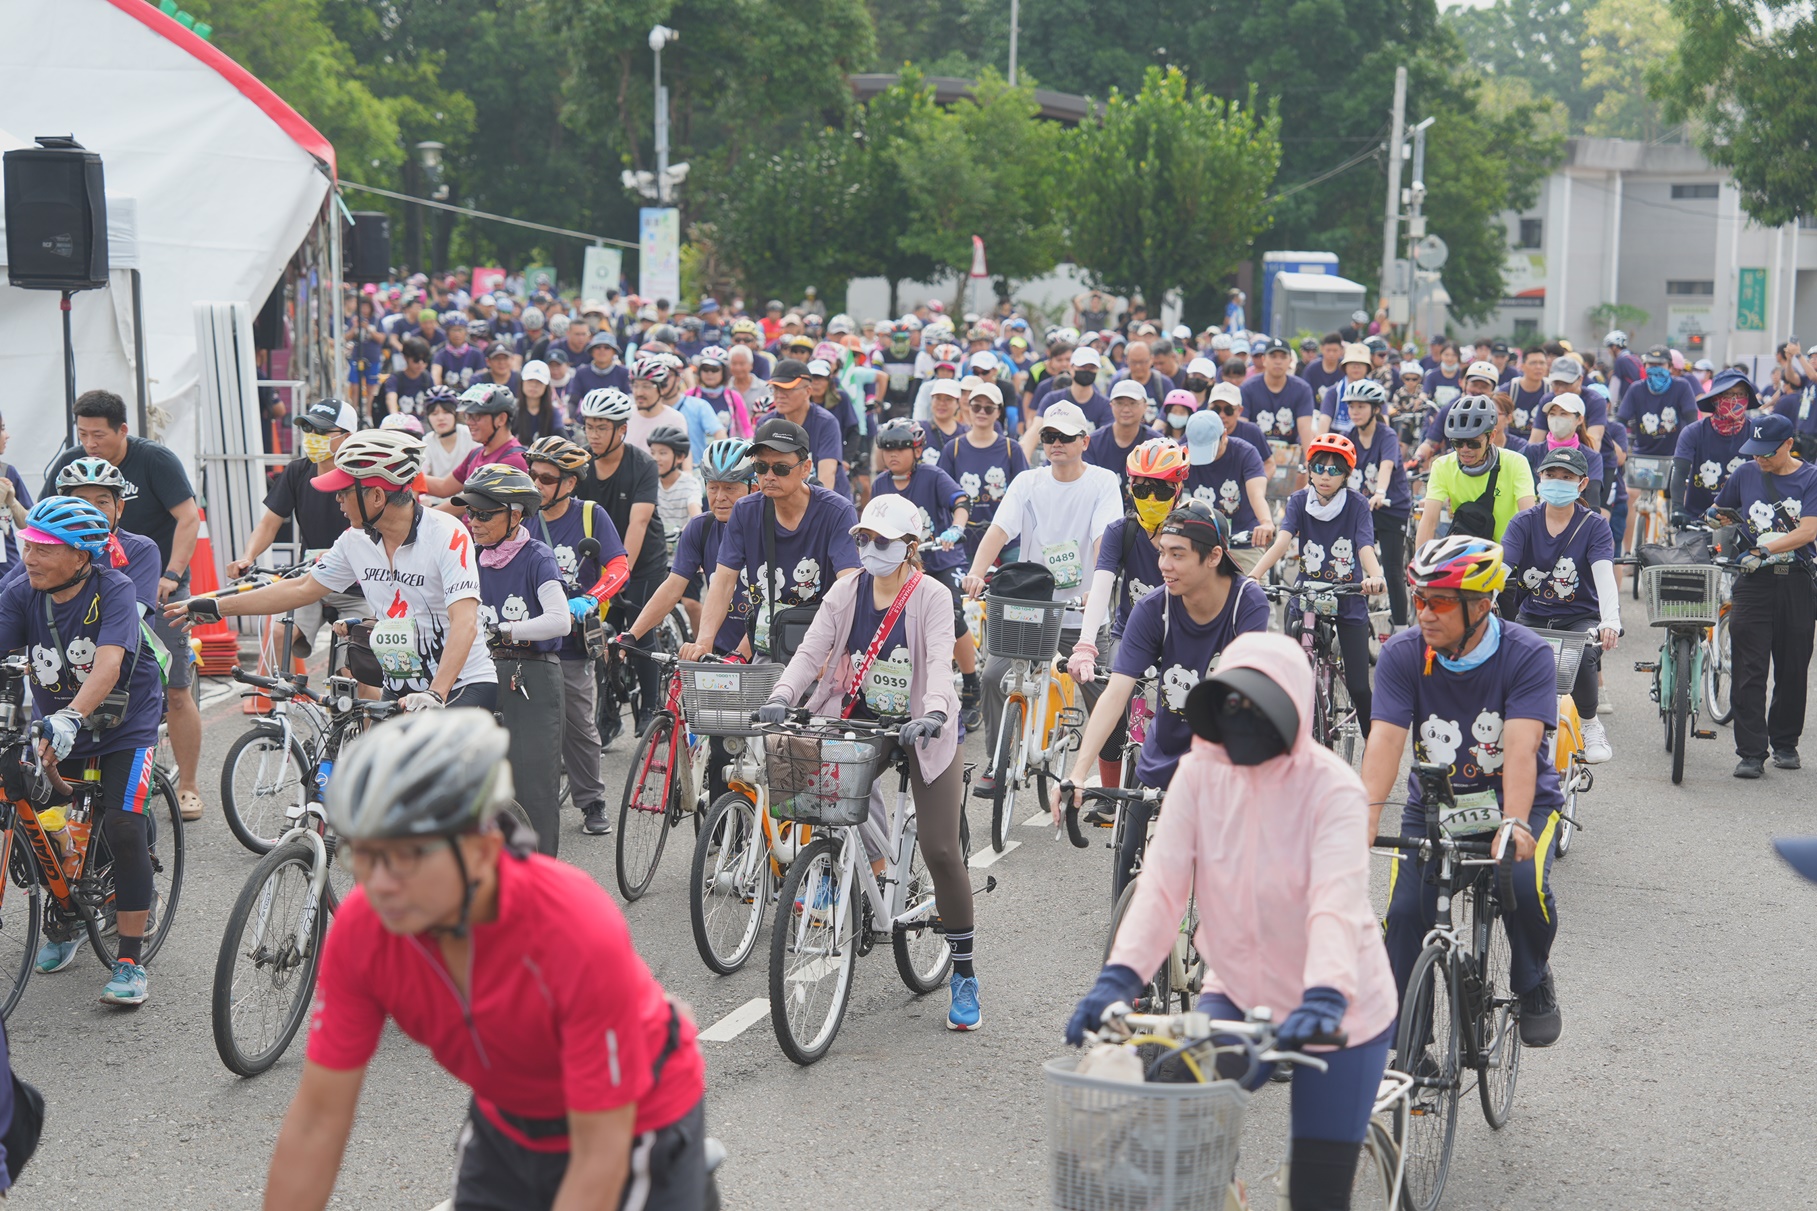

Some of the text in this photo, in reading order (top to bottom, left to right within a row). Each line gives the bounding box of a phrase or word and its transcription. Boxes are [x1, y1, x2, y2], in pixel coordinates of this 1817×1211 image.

[1753, 426, 1763, 438] K
[1049, 552, 1075, 565] 0489
[376, 633, 407, 645] 0305
[873, 674, 907, 689] 0939
[1448, 809, 1491, 824] 1113
[21, 818, 61, 881] GIANT
